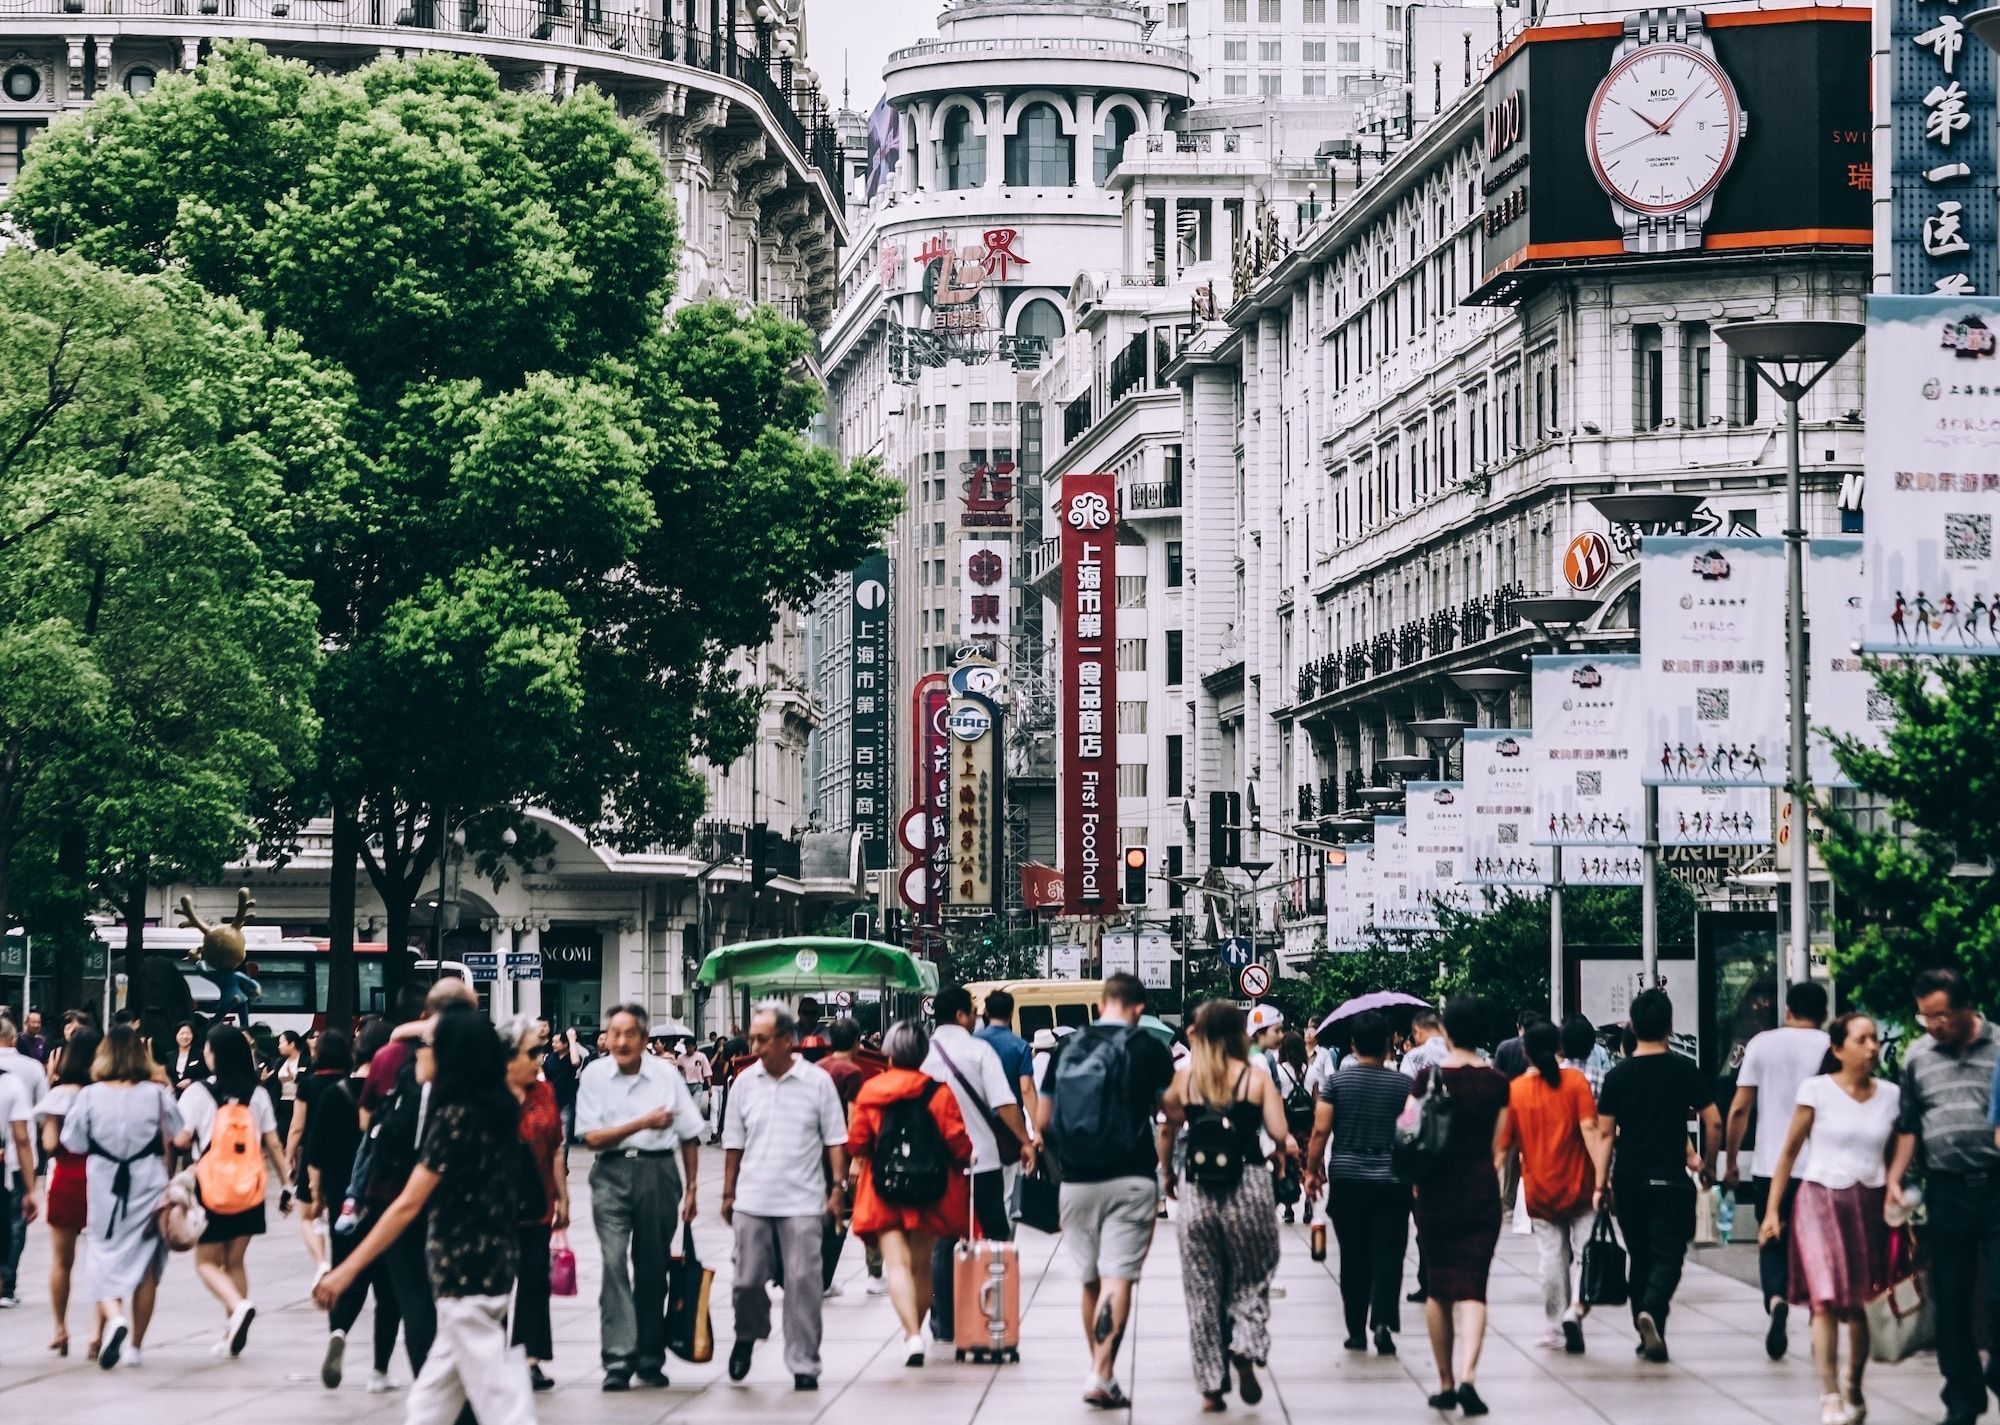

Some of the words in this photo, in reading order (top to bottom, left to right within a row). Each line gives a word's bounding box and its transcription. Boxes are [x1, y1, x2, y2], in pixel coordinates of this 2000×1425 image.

[1488, 89, 1521, 162] MIDO
[1650, 88, 1675, 97] MIDO
[1833, 131, 1871, 143] SWI
[1913, 0, 1976, 295] 市第一医
[877, 620, 885, 681] SHANGHAI
[1077, 541, 1102, 758] 上海市第一食品商店
[856, 620, 875, 840] 上海市第一百货商店
[949, 717, 989, 728] BAC
[1081, 771, 1099, 808] First
[1081, 813, 1099, 898] Foodhall
